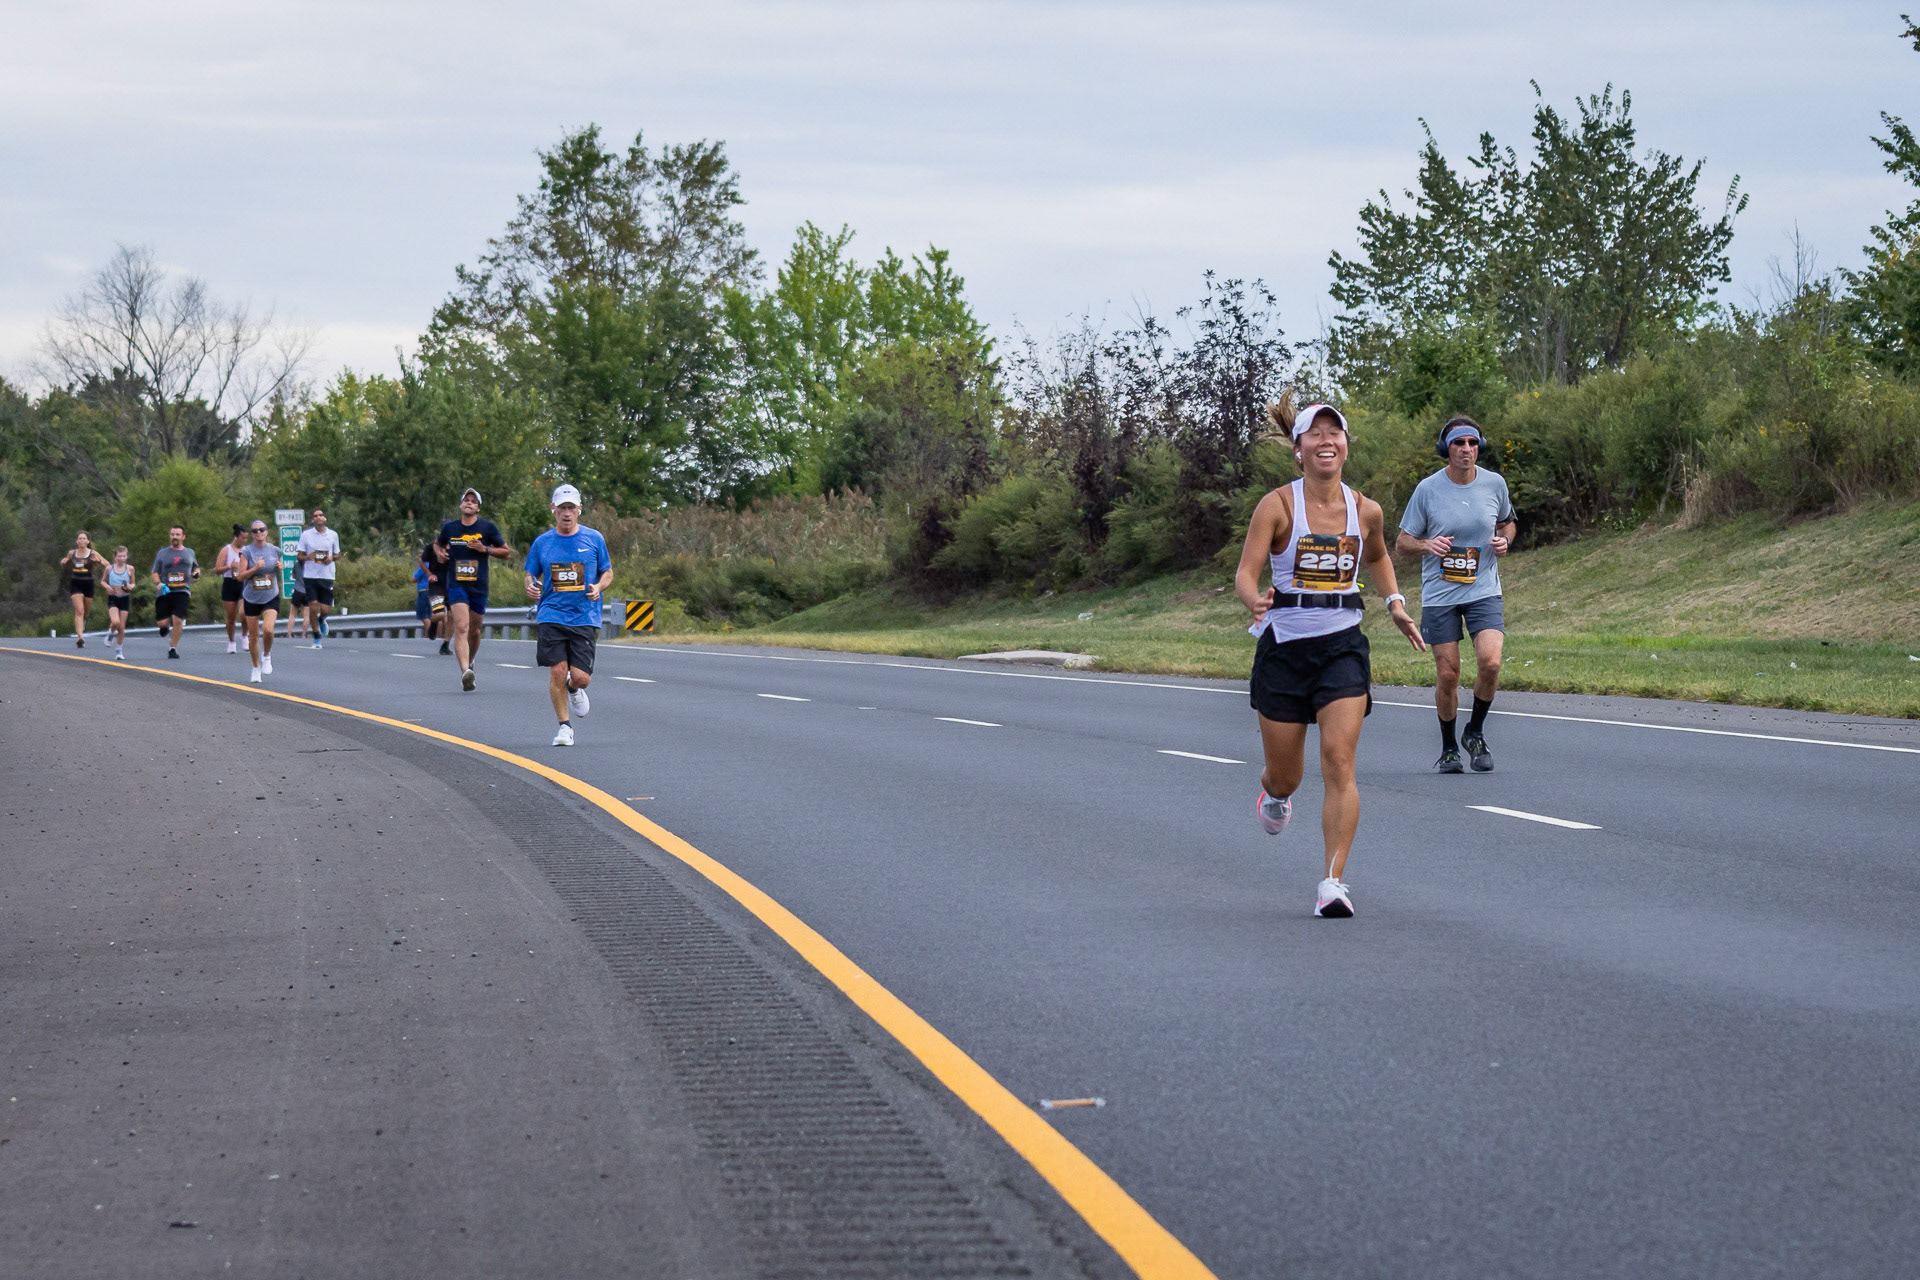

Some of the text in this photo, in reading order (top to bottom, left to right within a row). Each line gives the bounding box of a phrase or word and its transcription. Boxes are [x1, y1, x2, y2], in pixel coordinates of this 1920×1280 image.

[278, 513, 302, 521] BY-PASS
[283, 529, 300, 538] SOUTH
[1299, 552, 1355, 571] 226
[1442, 557, 1477, 570] 292
[558, 571, 578, 581] 59
